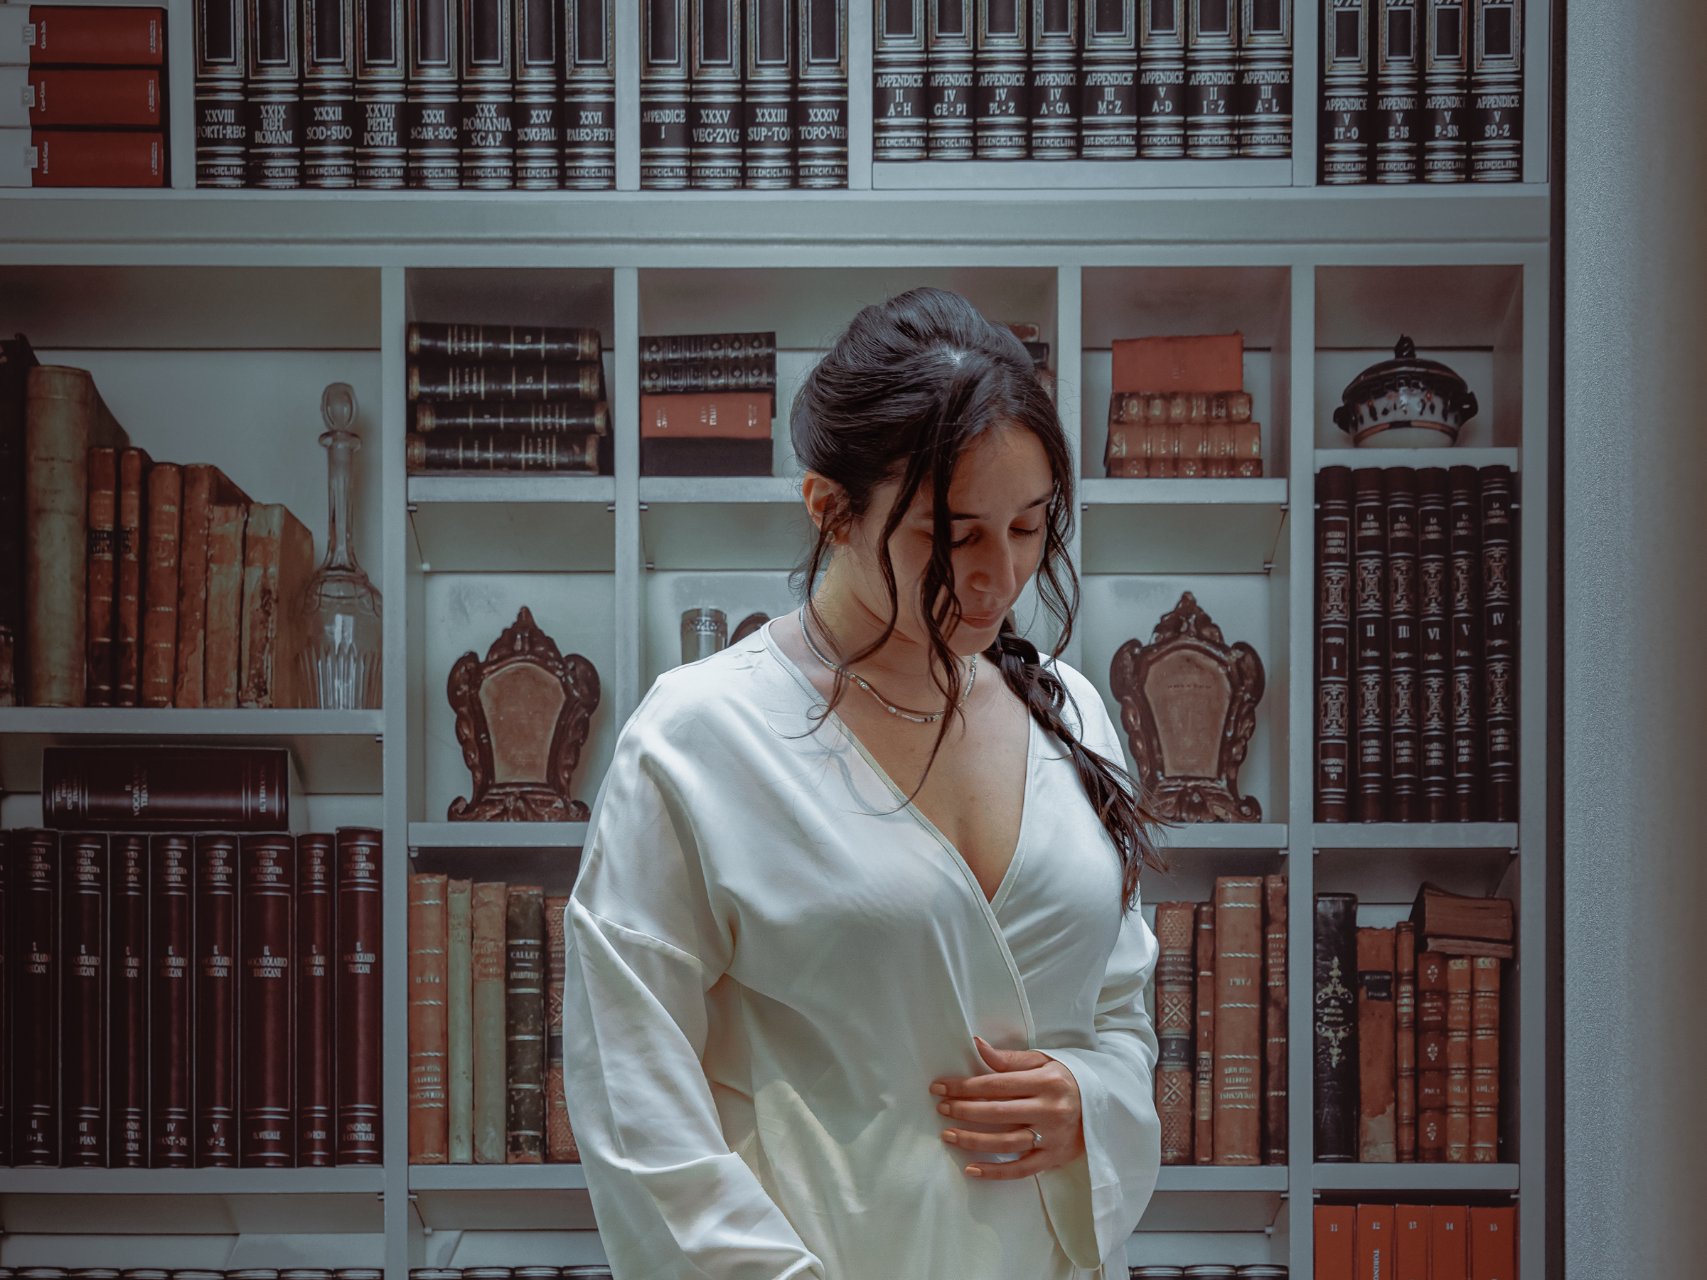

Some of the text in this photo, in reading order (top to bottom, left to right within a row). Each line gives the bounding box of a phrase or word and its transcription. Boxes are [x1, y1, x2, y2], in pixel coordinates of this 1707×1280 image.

[876, 75, 923, 87] APPENDICE
[930, 74, 973, 87] APPENDICE
[979, 74, 1025, 87] APPENDICE
[1086, 73, 1133, 86] APPENDICE
[1141, 72, 1184, 84] APPENDICE
[1243, 71, 1289, 84] APPENDICE
[896, 90, 903, 102] II
[944, 90, 956, 102] IV
[995, 89, 1007, 101] IV
[1051, 88, 1061, 101] IV
[1105, 88, 1114, 100] III
[1159, 88, 1166, 98] V
[1210, 88, 1217, 99] II
[1261, 87, 1271, 98] III
[1325, 98, 1367, 110] APPENDICE
[1476, 95, 1519, 108] APPENDICE
[205, 110, 234, 123] XXVIII
[260, 106, 285, 118] XXIX
[314, 107, 342, 121] XXXII
[366, 105, 395, 118] XXVII
[422, 110, 445, 123] XXXI
[476, 105, 496, 117] XXX
[530, 110, 552, 124] XXV
[580, 111, 602, 124] XXVI
[643, 110, 685, 123] APPENDICE
[700, 110, 730, 124] XXXV
[756, 109, 787, 122] XXXIII
[808, 109, 839, 122] XXXIV
[1444, 111, 1452, 123] V
[1493, 111, 1501, 122] V
[368, 118, 393, 130] PETH
[463, 118, 511, 131] ROMANIA
[1343, 113, 1351, 126] V
[1395, 113, 1403, 125] V
[255, 131, 293, 144] ROMANI
[471, 133, 502, 146] SCAP
[1492, 612, 1505, 625] IV
[1366, 624, 1375, 637] II
[1398, 625, 1410, 638] III
[1428, 628, 1440, 640] VI
[1461, 624, 1471, 636] V
